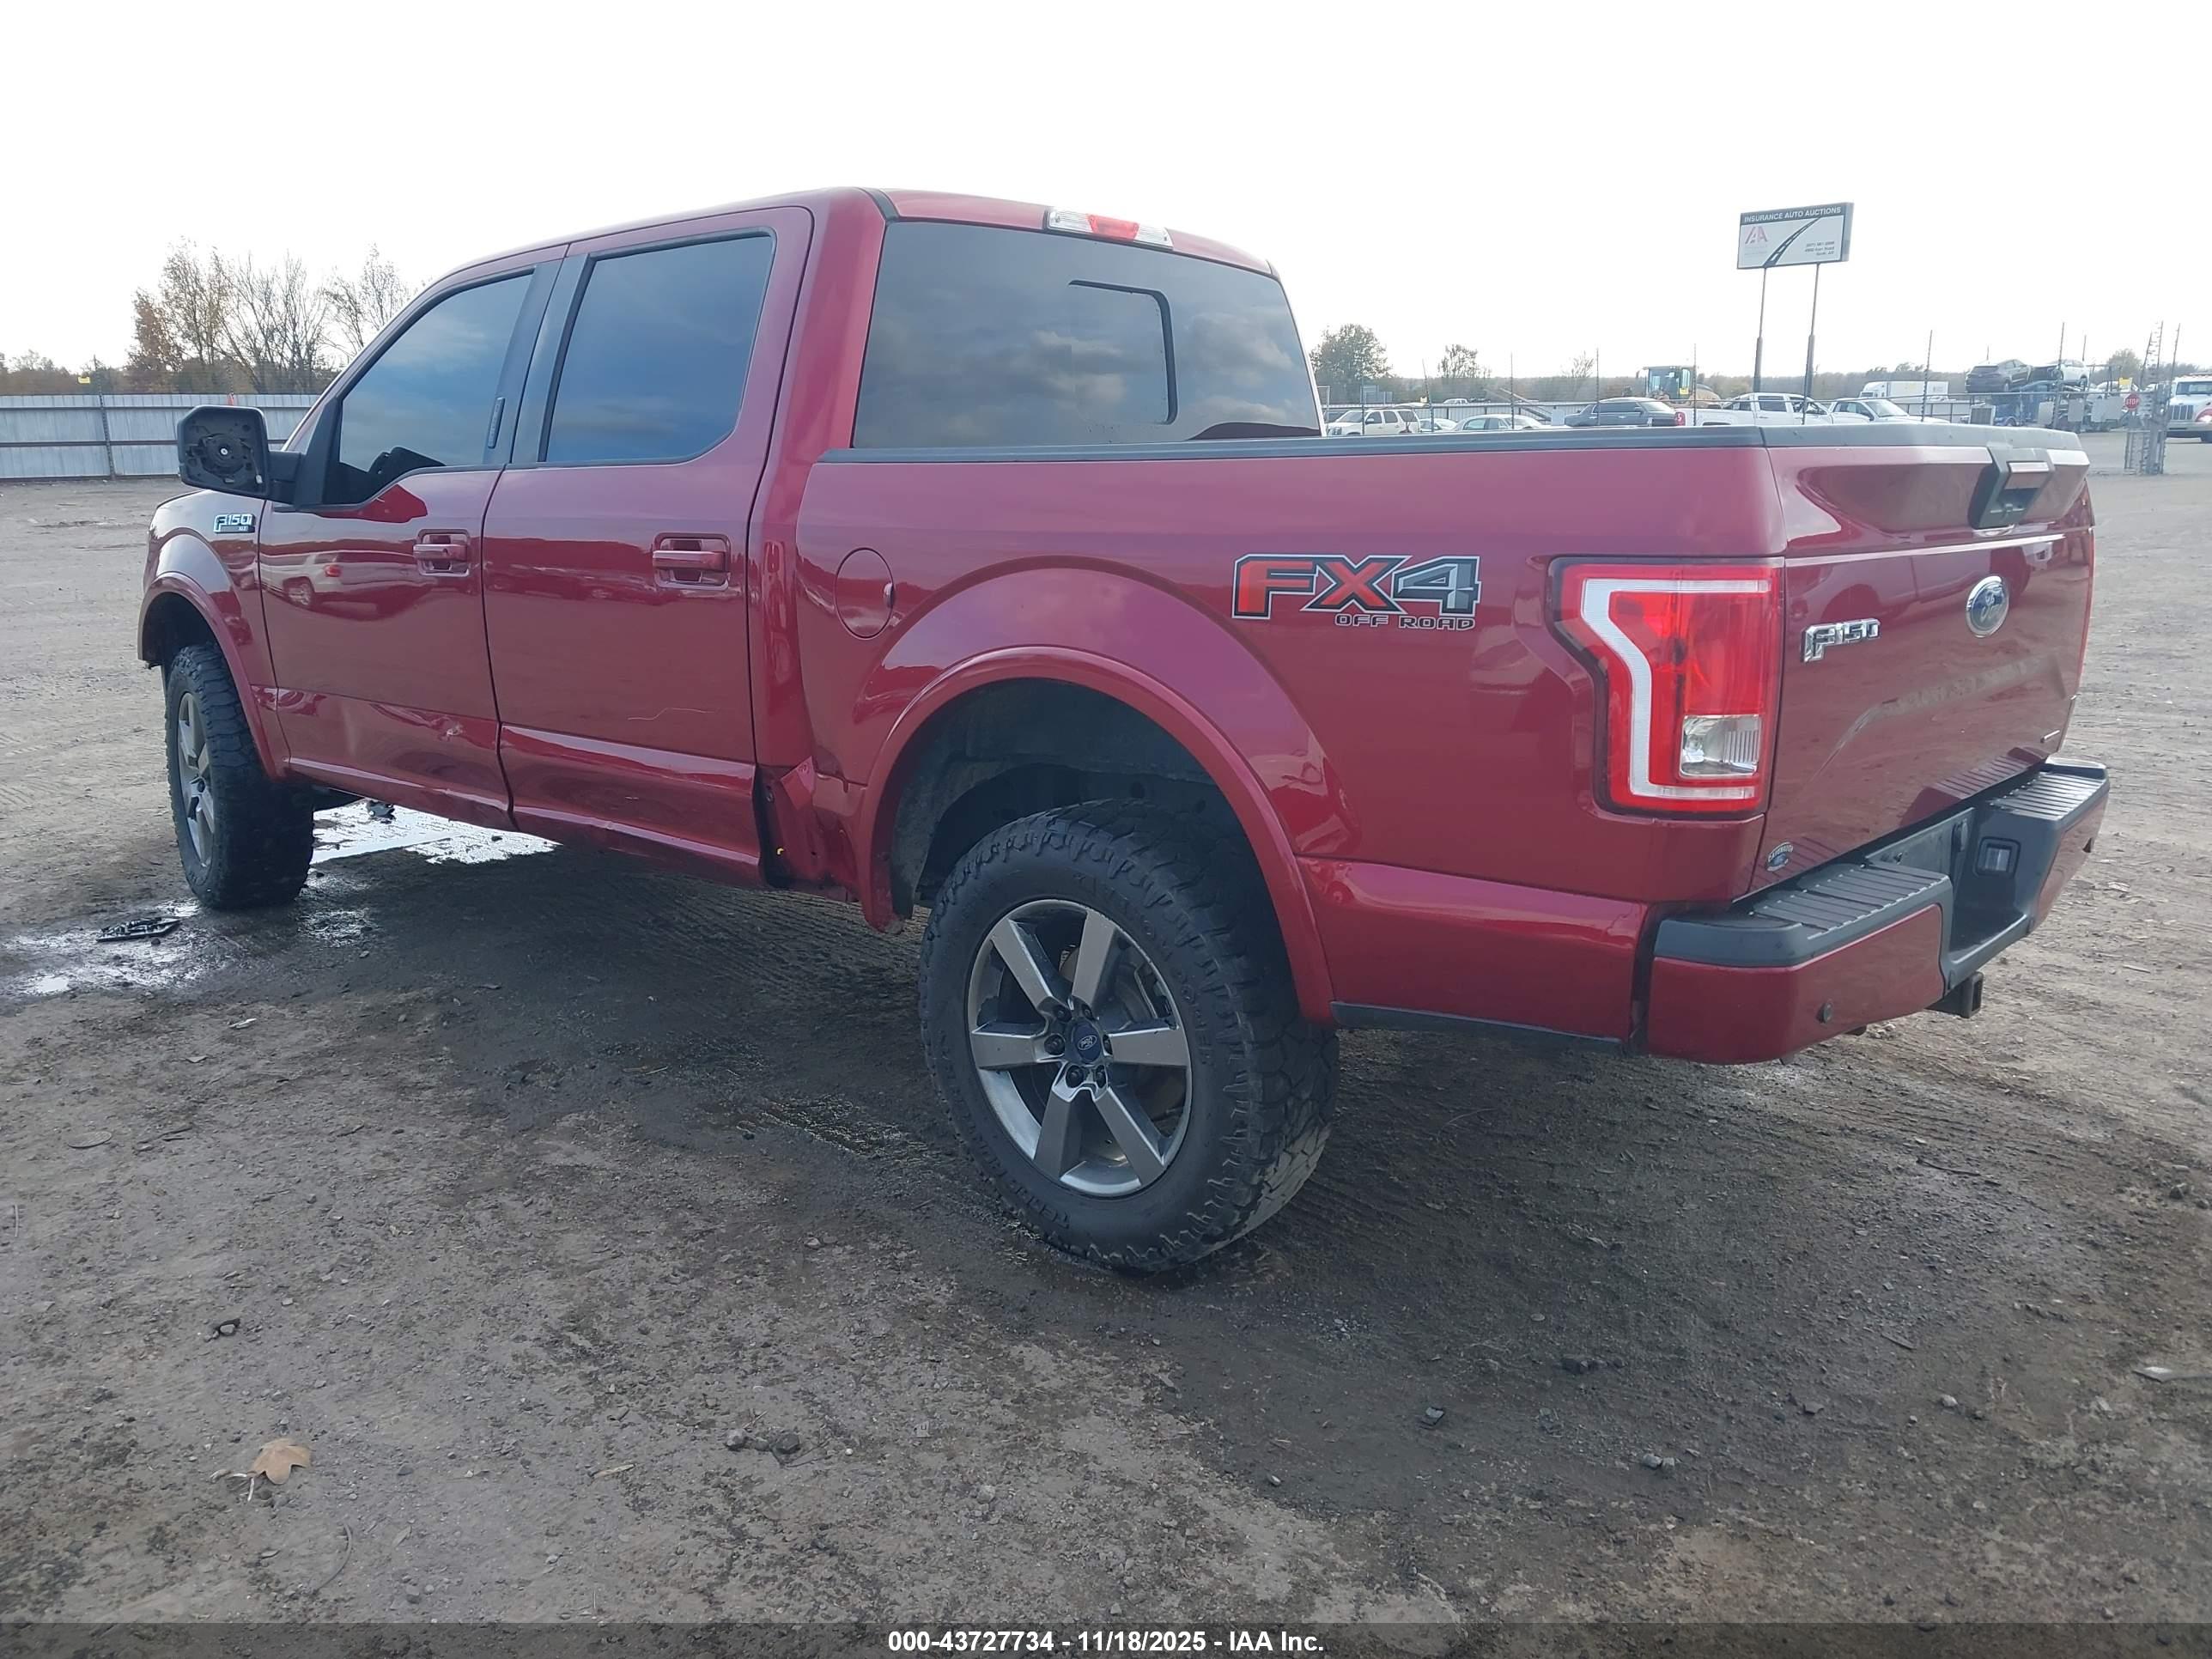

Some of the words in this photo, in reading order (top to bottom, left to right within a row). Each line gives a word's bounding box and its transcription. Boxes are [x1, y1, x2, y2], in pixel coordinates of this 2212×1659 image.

[1744, 212, 1784, 222] INSURANCE
[1805, 206, 1842, 217] AUCTIONS
[2125, 398, 2139, 406] STOP
[1231, 553, 1482, 619] FX4
[1334, 613, 1389, 628] OFF
[1398, 614, 1476, 631] ROAD
